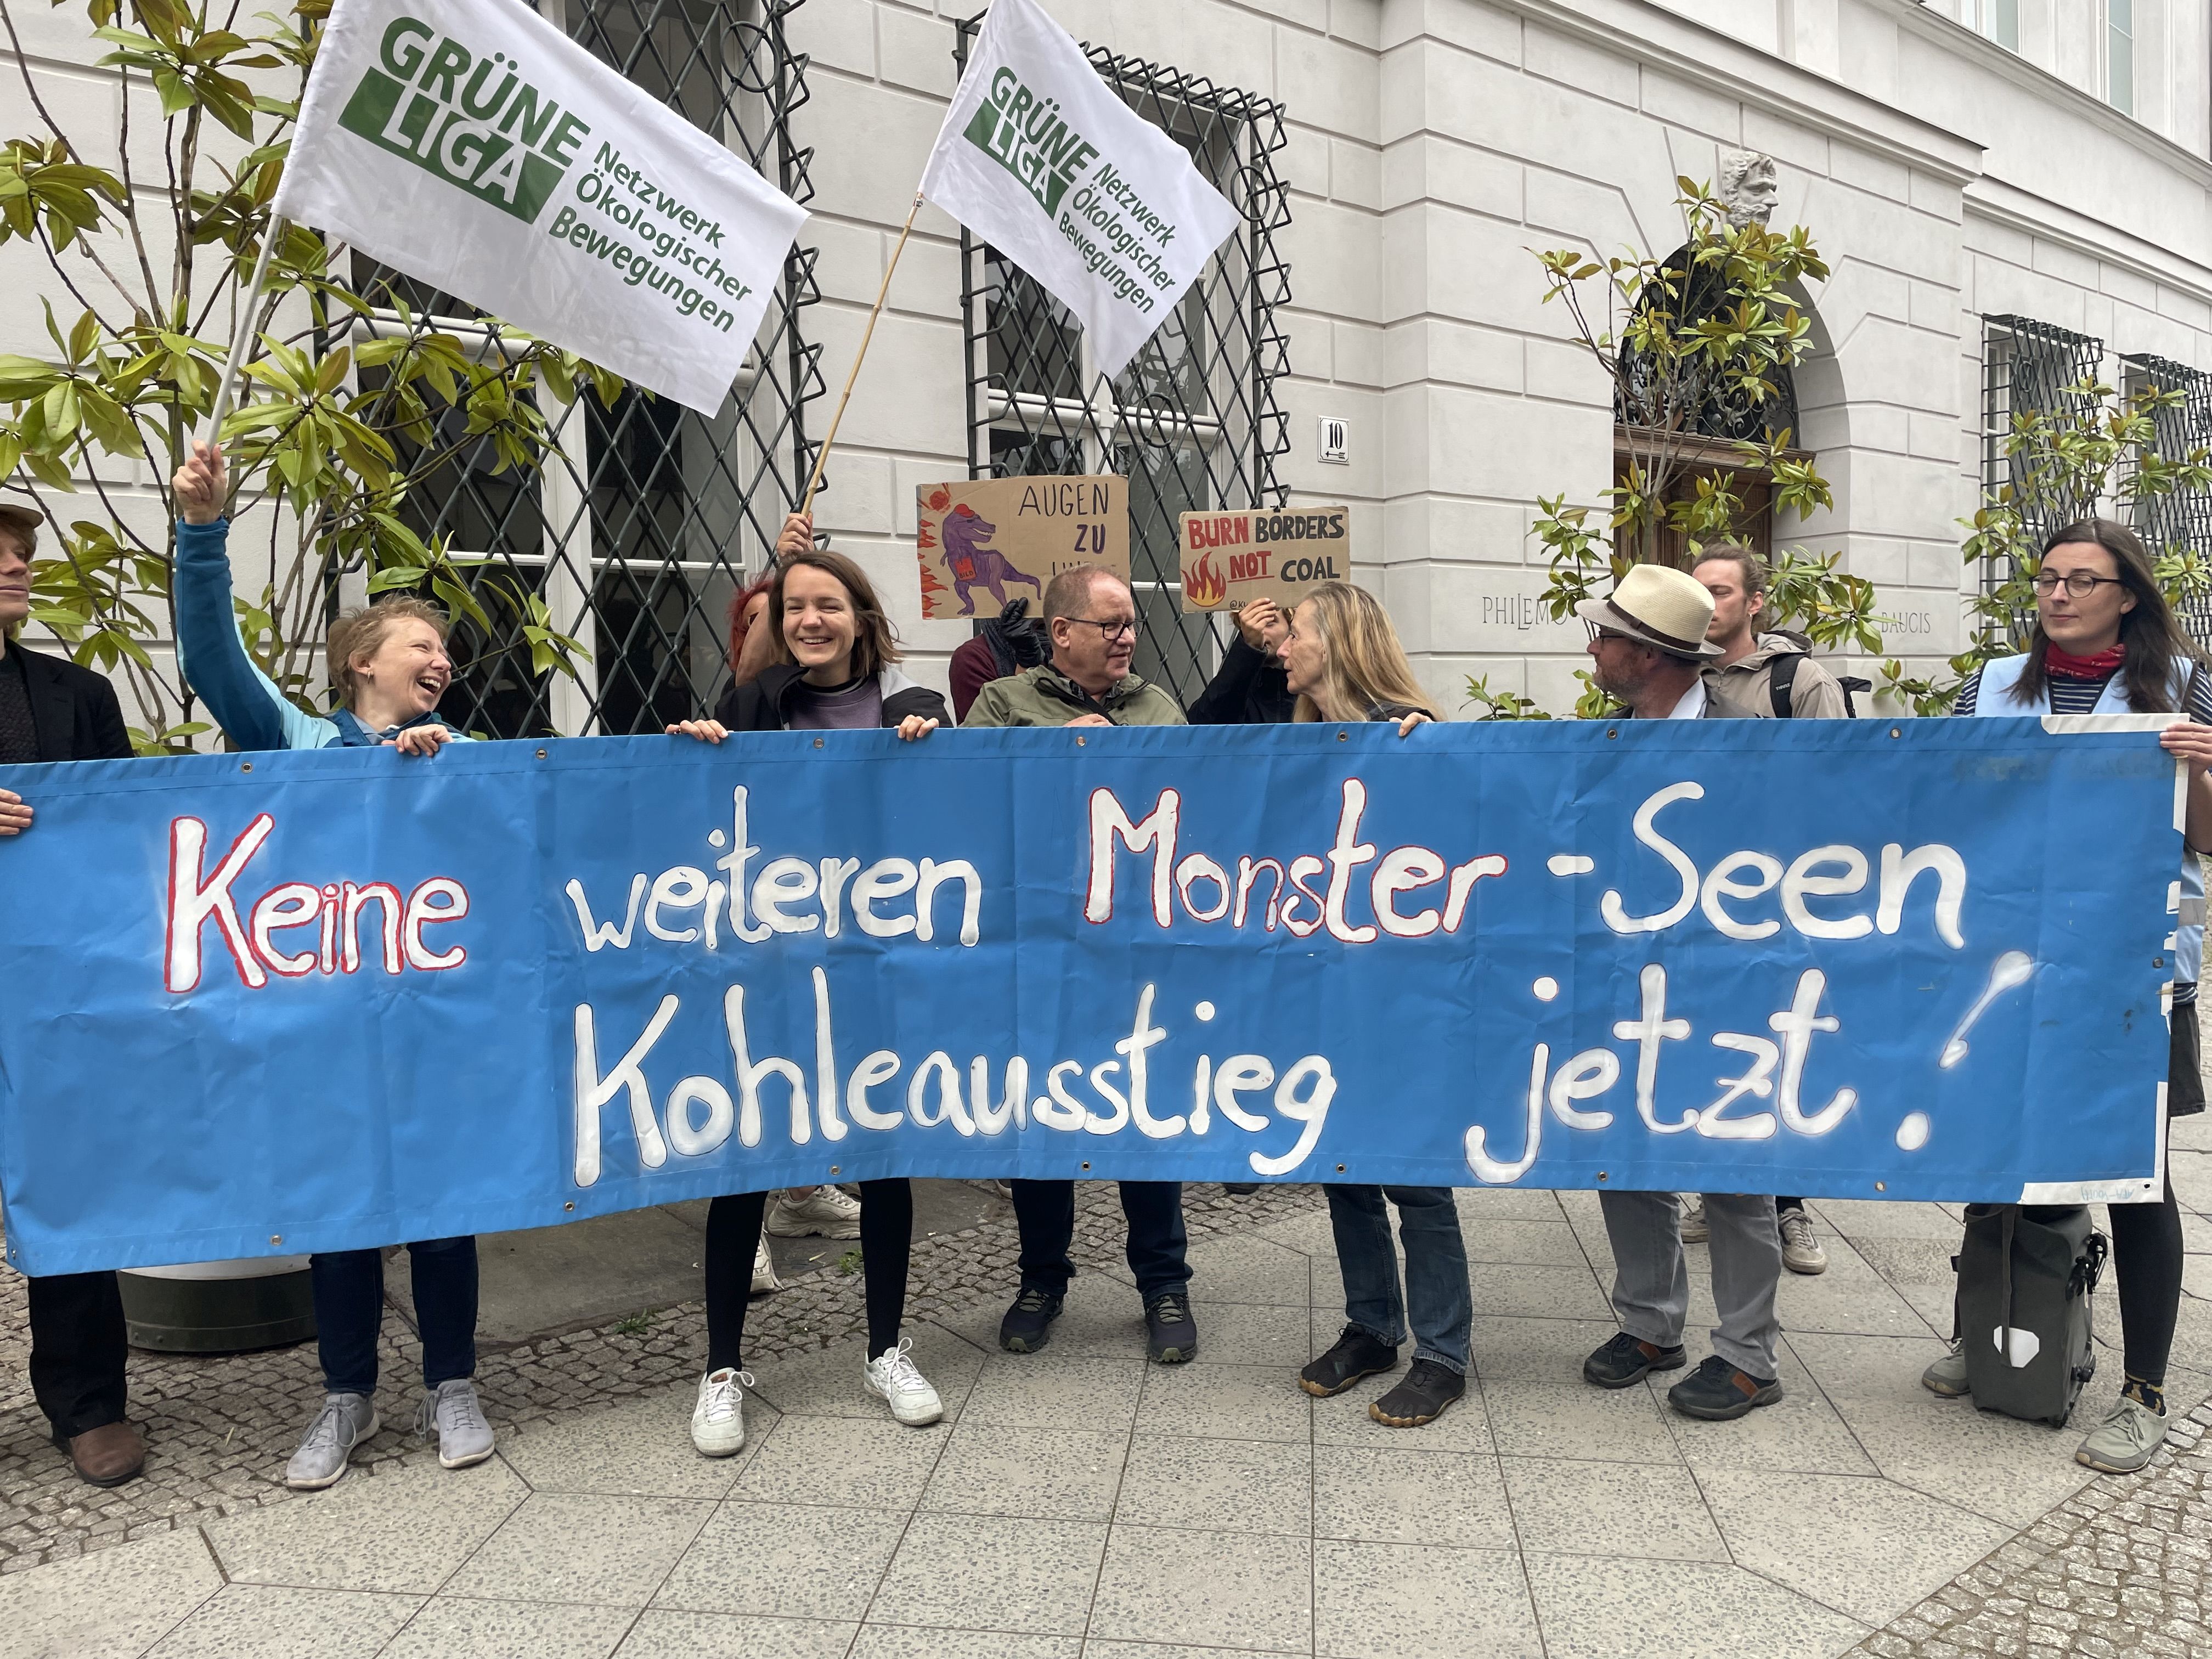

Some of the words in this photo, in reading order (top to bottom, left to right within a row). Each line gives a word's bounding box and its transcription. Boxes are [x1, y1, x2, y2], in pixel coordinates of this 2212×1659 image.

[380, 16, 591, 168] GRÜNE
[991, 66, 1100, 183] GRÜNE
[380, 84, 528, 204] LIGA
[594, 141, 726, 249] Netzwerk
[988, 111, 1054, 204] LIGA
[576, 168, 752, 302] Ökologischer
[1073, 184, 1176, 291] Ökologischer
[1092, 163, 1176, 248] Netzwerk
[549, 205, 735, 333] Bewegungen
[1059, 211, 1154, 314] Bewegungen
[1328, 422, 1343, 449] 10
[1018, 483, 1109, 517] AUGEN
[1074, 523, 1107, 554] ZU
[1188, 516, 1250, 549] BURN
[1255, 515, 1345, 543] BORDERS
[959, 571, 974, 579] BILD
[1229, 551, 1272, 580] NOT
[1280, 556, 1340, 583] COAL
[1881, 612, 1931, 634] BAUCIS
[163, 812, 470, 994] Keine
[565, 785, 982, 952] weiteren
[574, 965, 1337, 1188] Kohleausstieg
